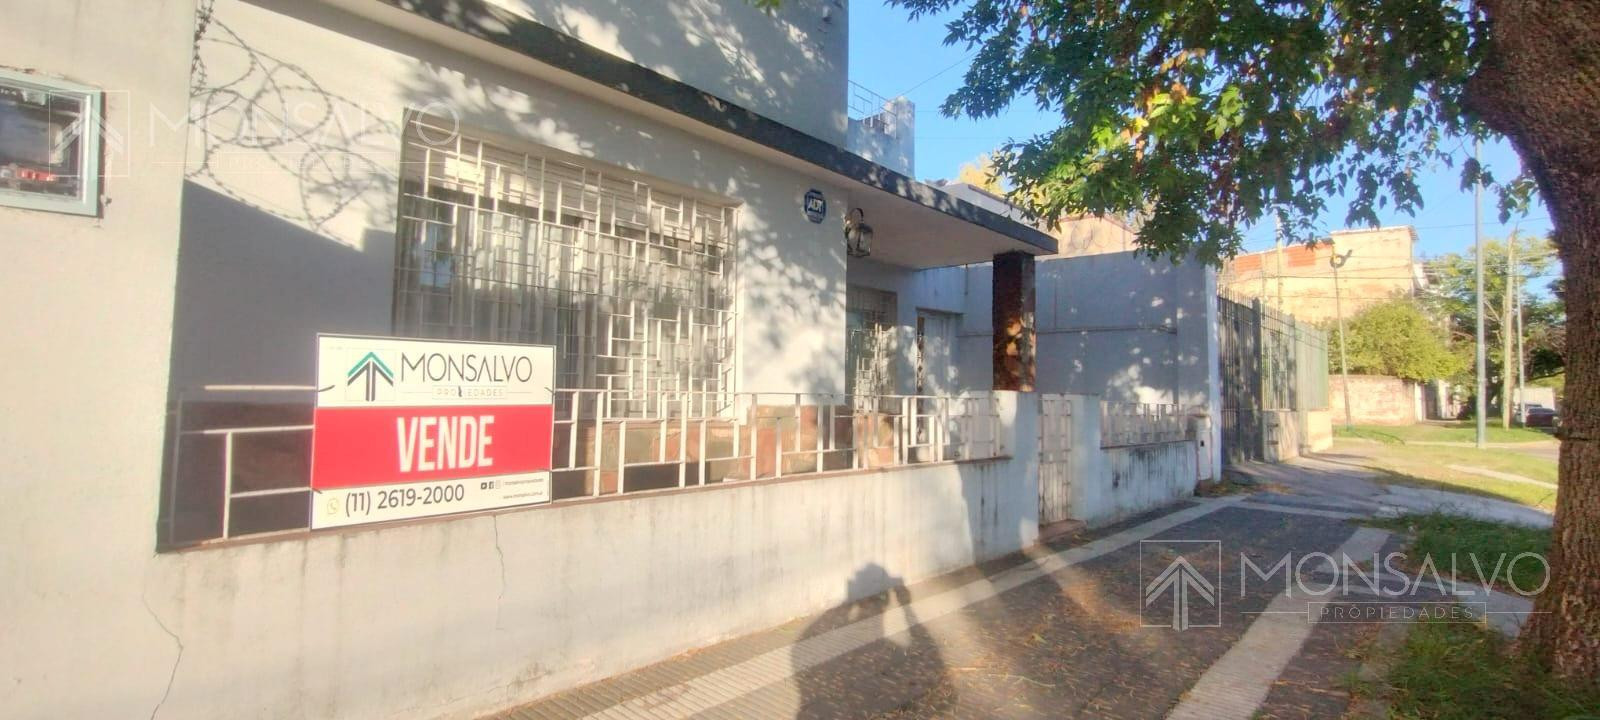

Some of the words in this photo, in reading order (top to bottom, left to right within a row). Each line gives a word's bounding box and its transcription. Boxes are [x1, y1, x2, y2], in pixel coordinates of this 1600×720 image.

[401, 352, 533, 383] MONSALVO
[396, 415, 495, 473] VENDE
[345, 491, 371, 517] (11)
[377, 484, 465, 509] 2619-2000
